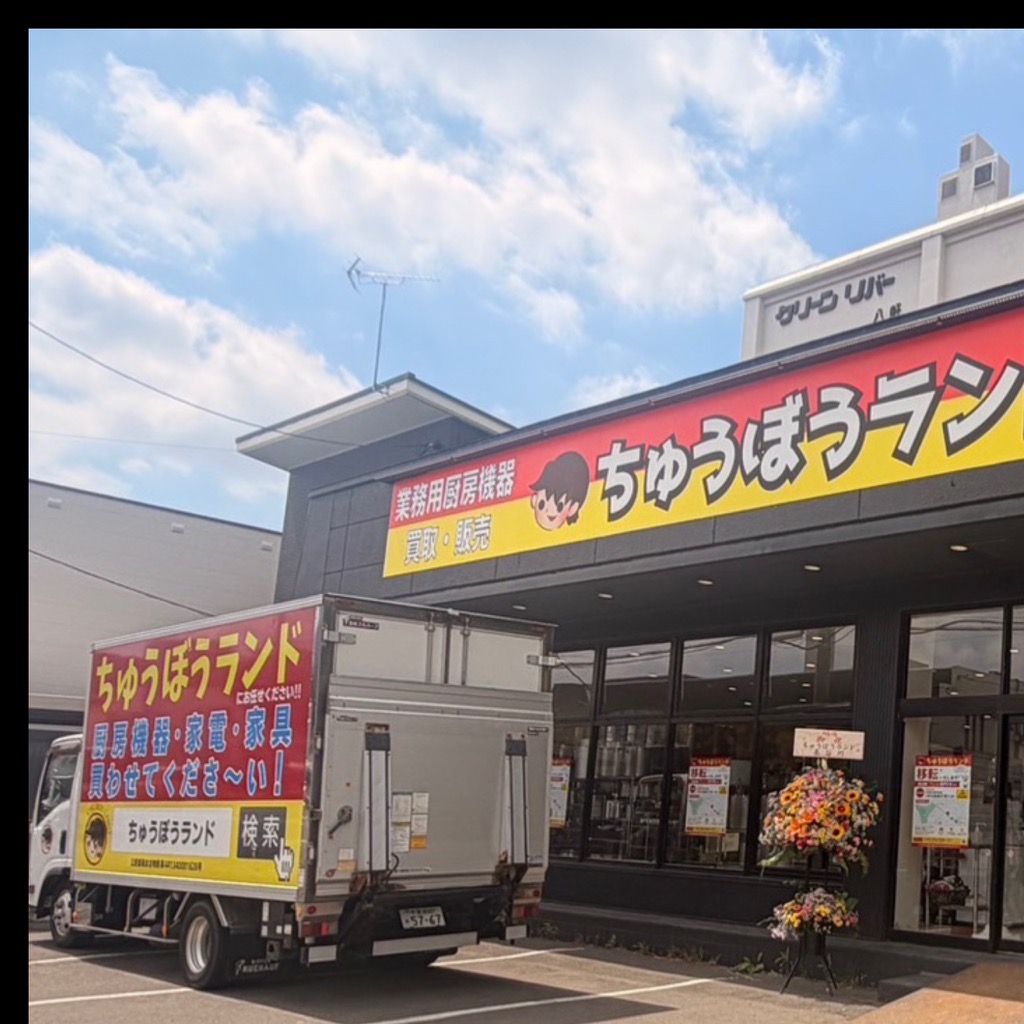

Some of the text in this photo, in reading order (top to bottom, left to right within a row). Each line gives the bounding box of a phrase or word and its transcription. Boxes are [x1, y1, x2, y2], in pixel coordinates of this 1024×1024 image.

[775, 273, 896, 326] グリーン リバー
[394, 457, 517, 523] 業務用厨房機器
[403, 513, 492, 566] 買取・販売
[128, 819, 216, 847] ちゅうぼうランド
[240, 813, 280, 848] 検索
